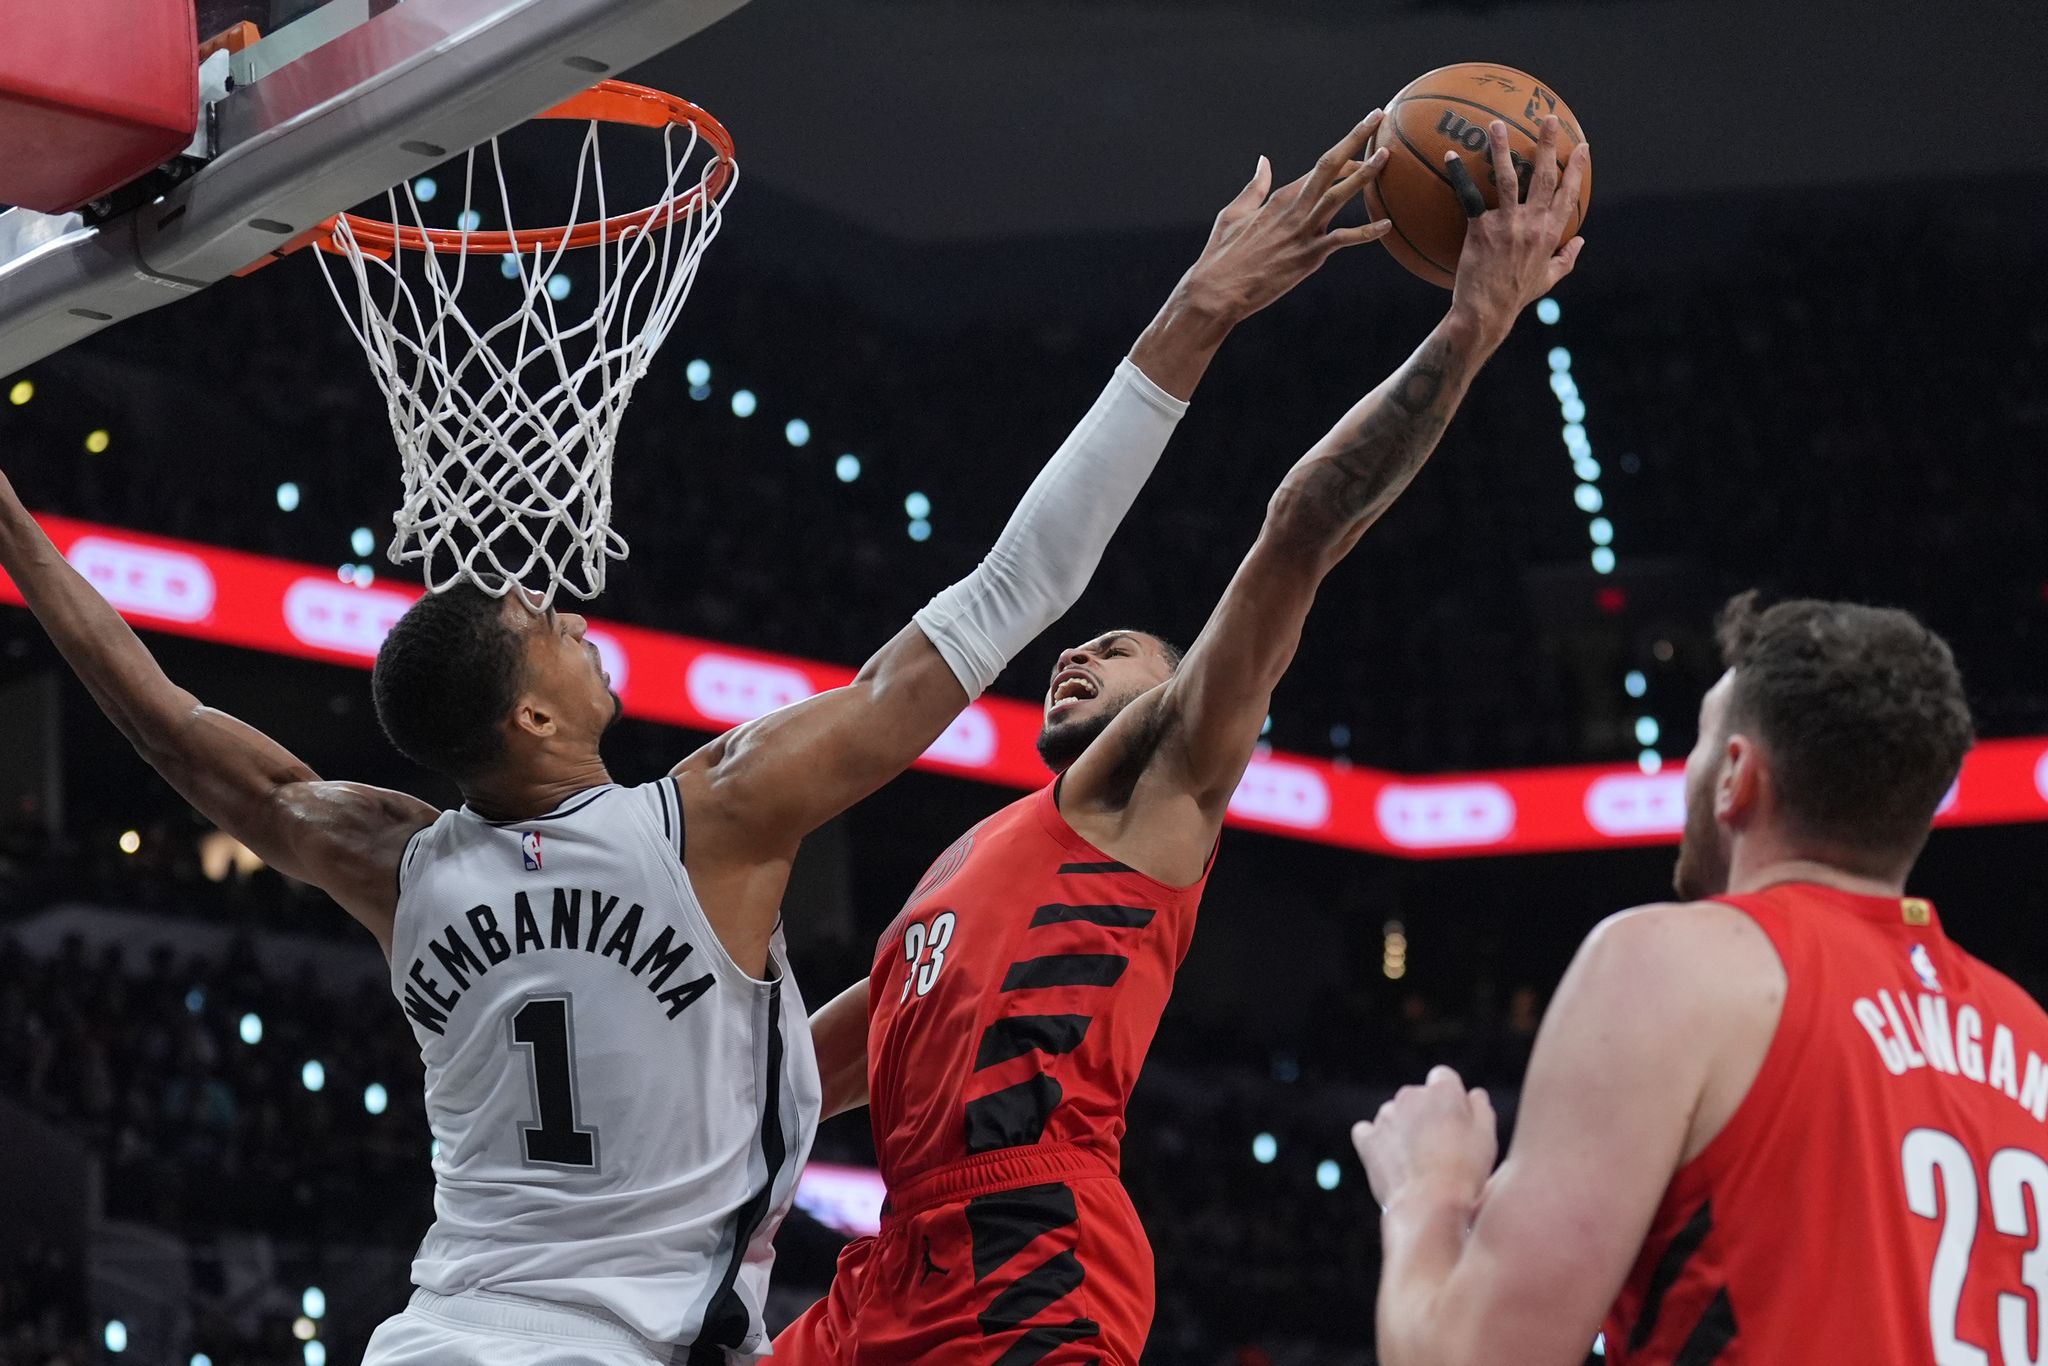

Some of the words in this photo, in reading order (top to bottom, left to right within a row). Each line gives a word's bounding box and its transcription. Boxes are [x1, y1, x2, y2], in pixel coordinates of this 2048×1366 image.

[404, 887, 716, 1037] WEMBANYAMA
[901, 911, 957, 1004] 33
[507, 992, 600, 1174] 1
[1901, 1127, 2048, 1366] 23
